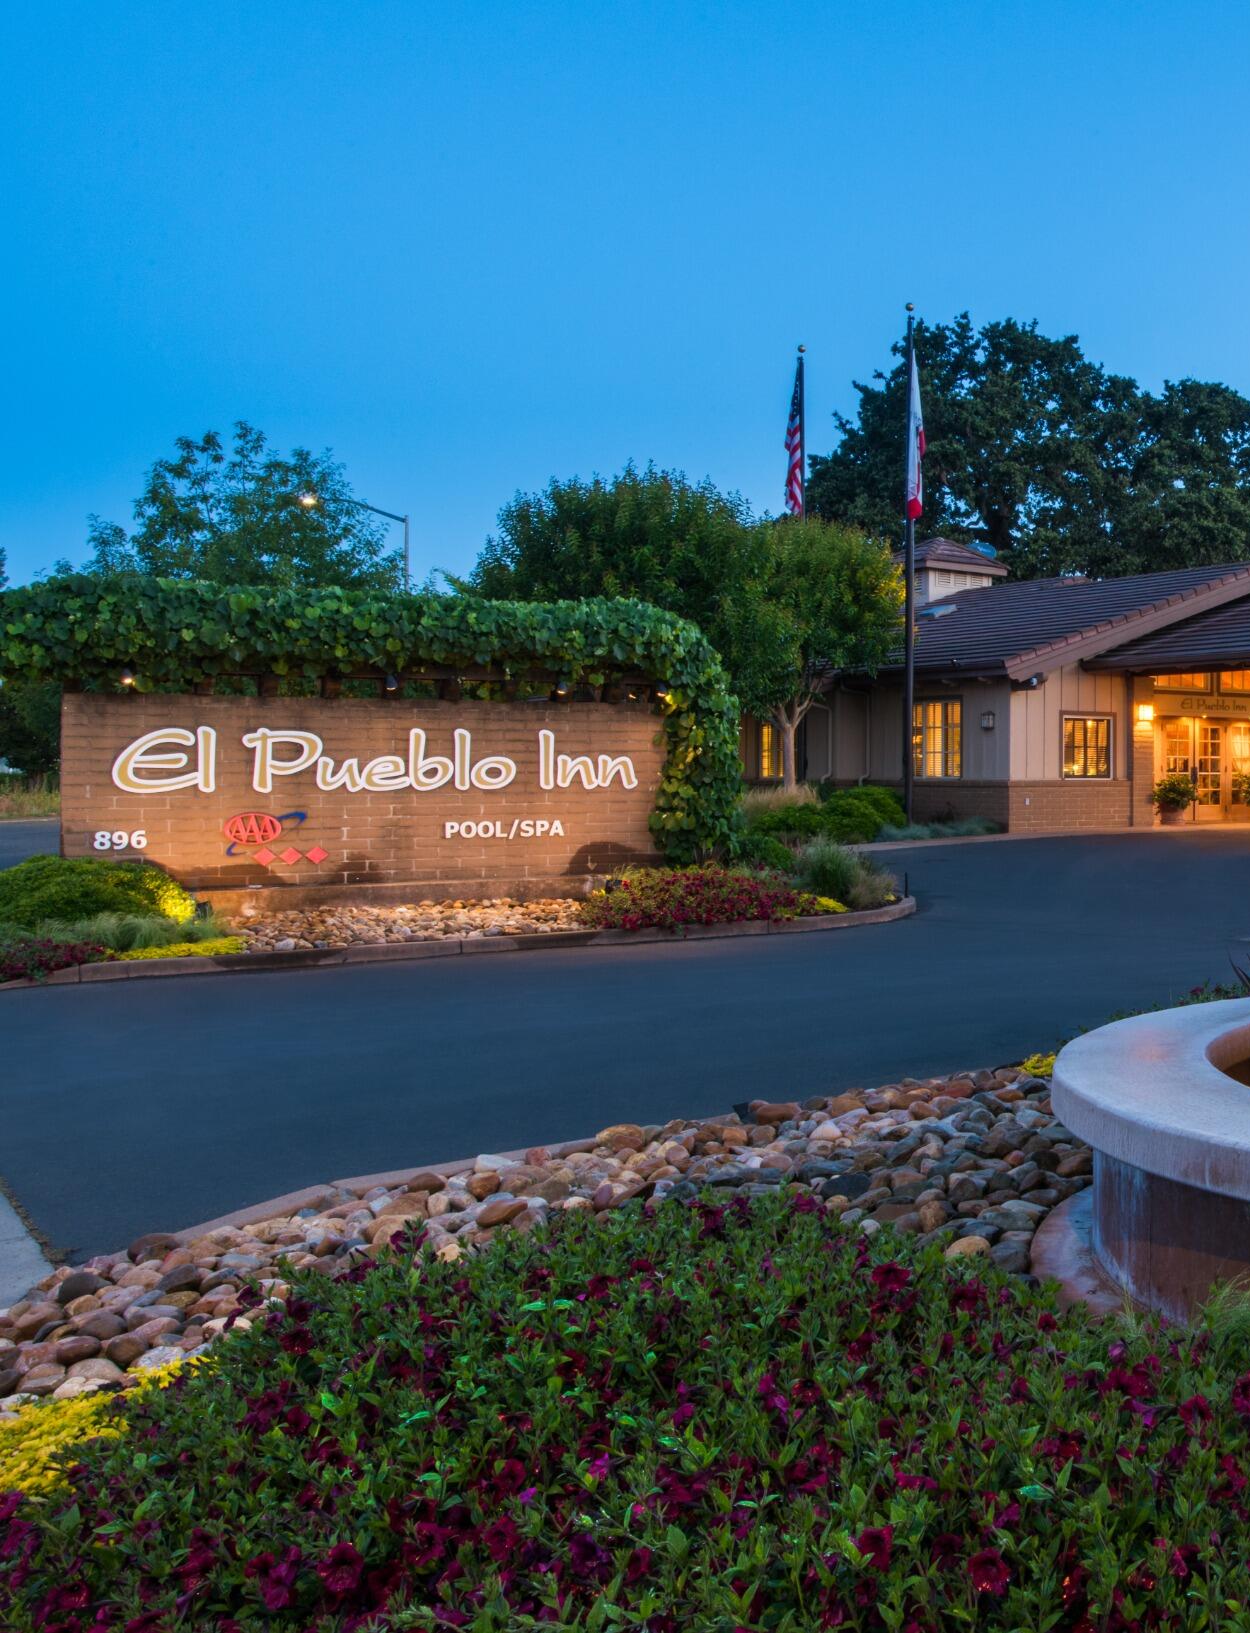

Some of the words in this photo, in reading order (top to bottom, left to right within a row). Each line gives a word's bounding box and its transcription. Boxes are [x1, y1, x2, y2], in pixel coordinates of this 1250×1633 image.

[1181, 698, 1193, 709] El
[1197, 699, 1230, 712] Pueblo
[1233, 700, 1247, 711] Inn
[112, 726, 216, 793] El
[243, 728, 516, 793] Pueblo
[538, 729, 637, 790] Inn
[230, 814, 277, 843] AAA
[445, 819, 565, 839] POOL/SPA
[93, 830, 147, 850] 896
